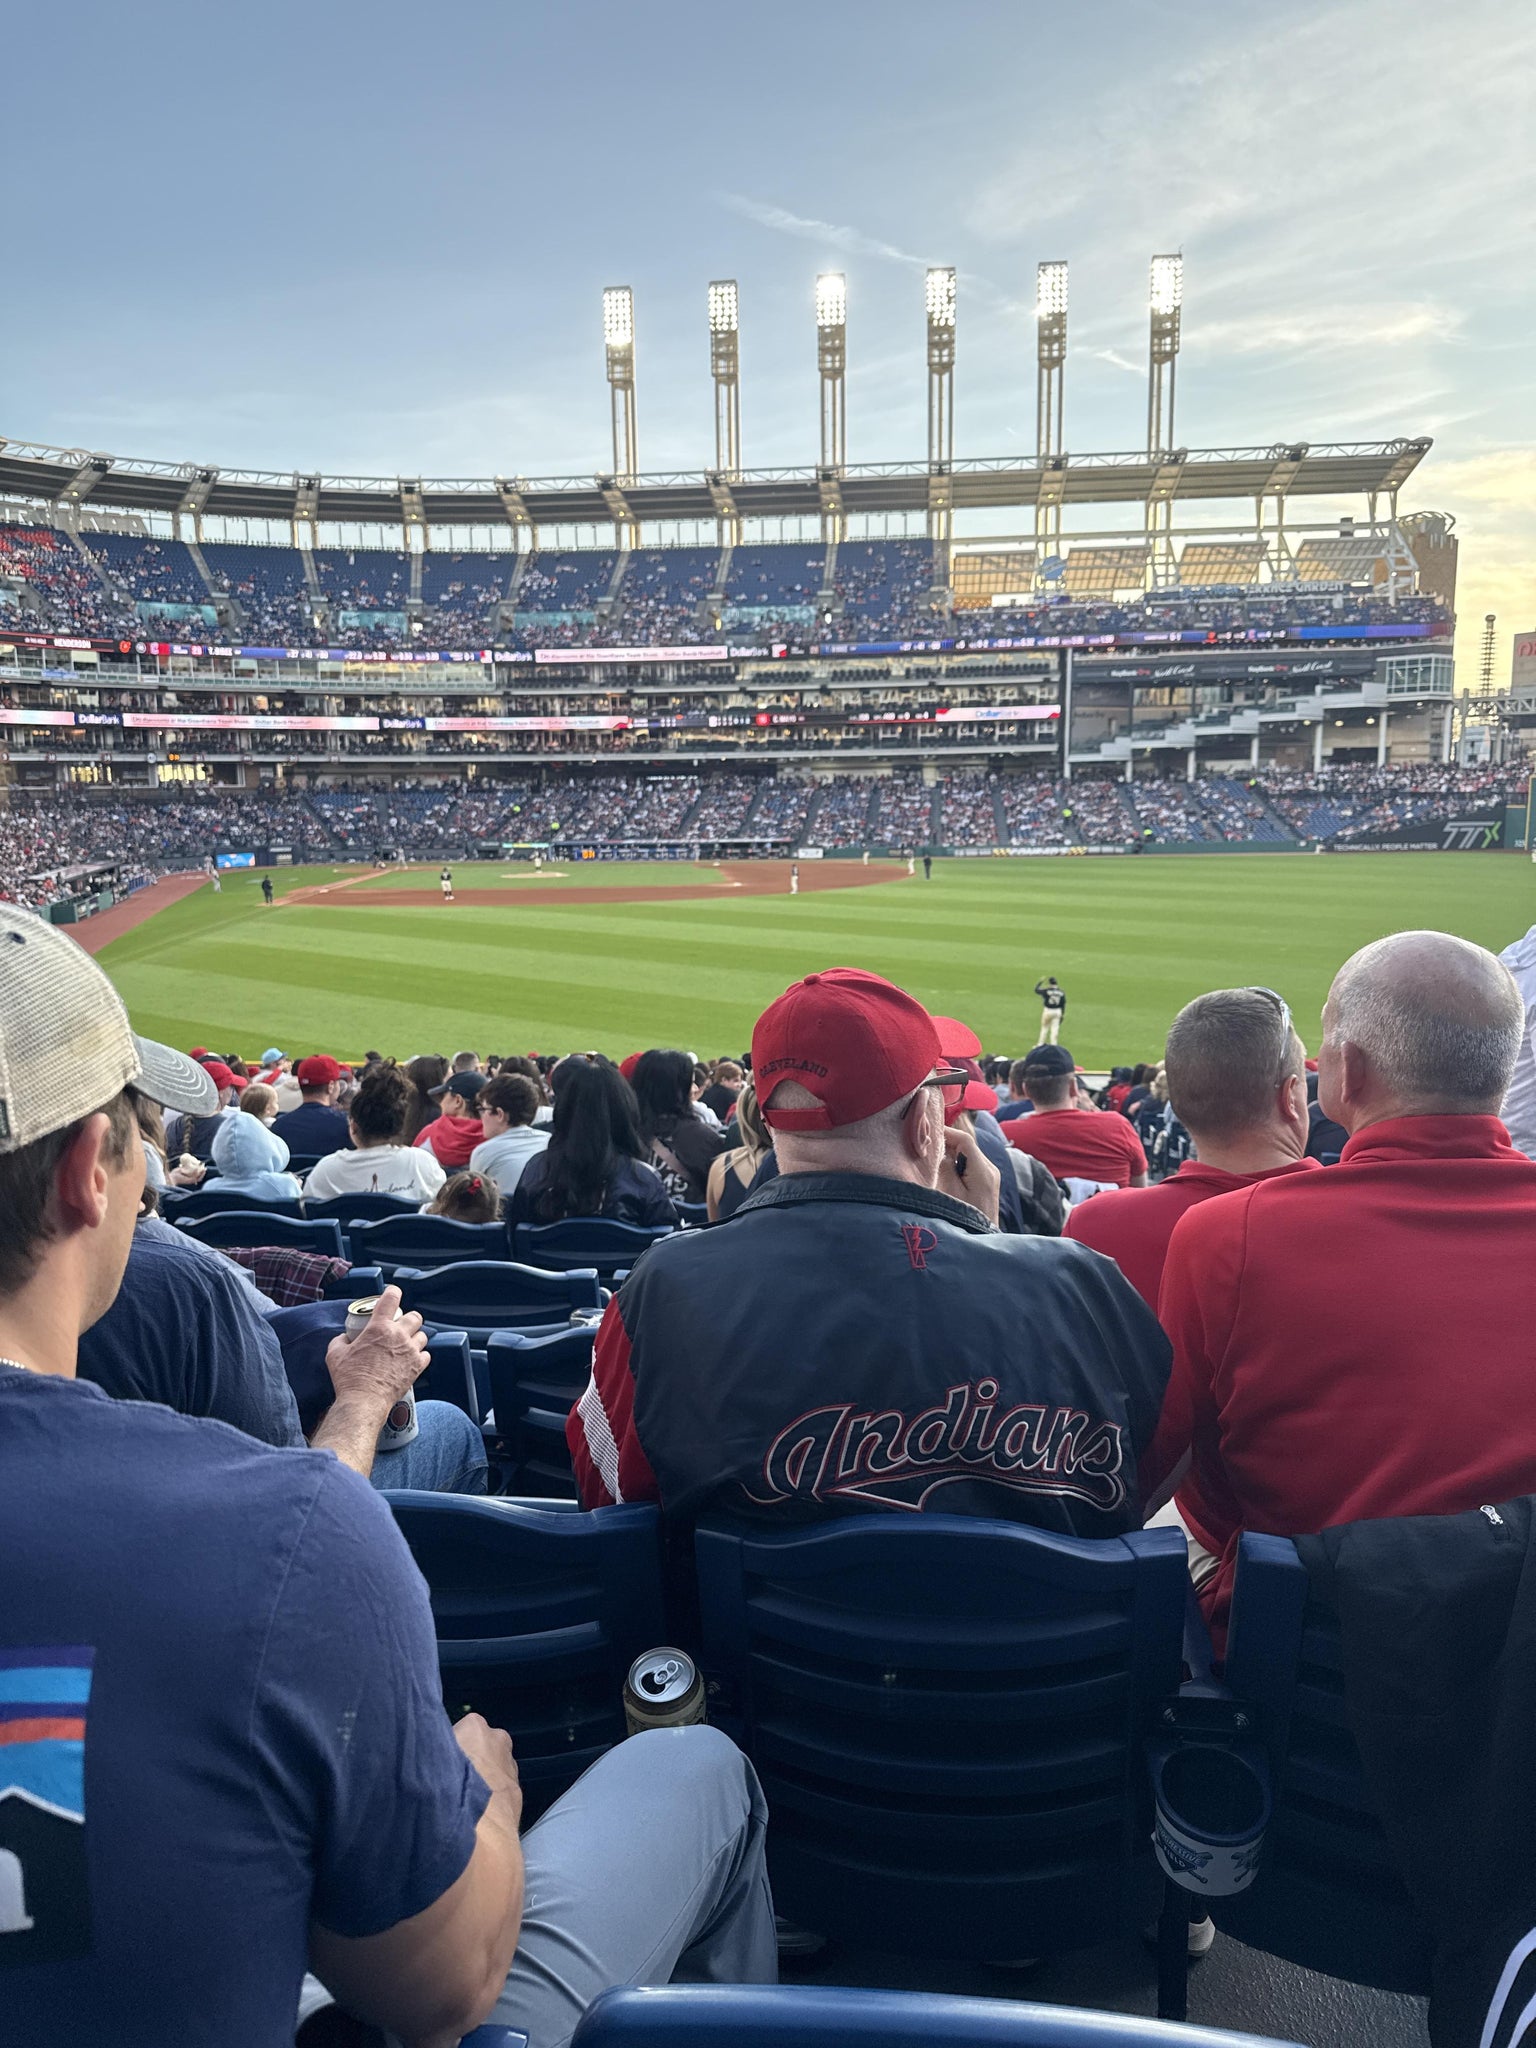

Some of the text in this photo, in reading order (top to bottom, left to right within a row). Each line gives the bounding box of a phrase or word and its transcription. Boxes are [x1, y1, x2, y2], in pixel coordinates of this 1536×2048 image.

[1244, 582, 1293, 594] TERRACE
[1296, 581, 1344, 592] GARDEN
[759, 1057, 829, 1079] CLEVELAND
[757, 1376, 1124, 1511] Indians
